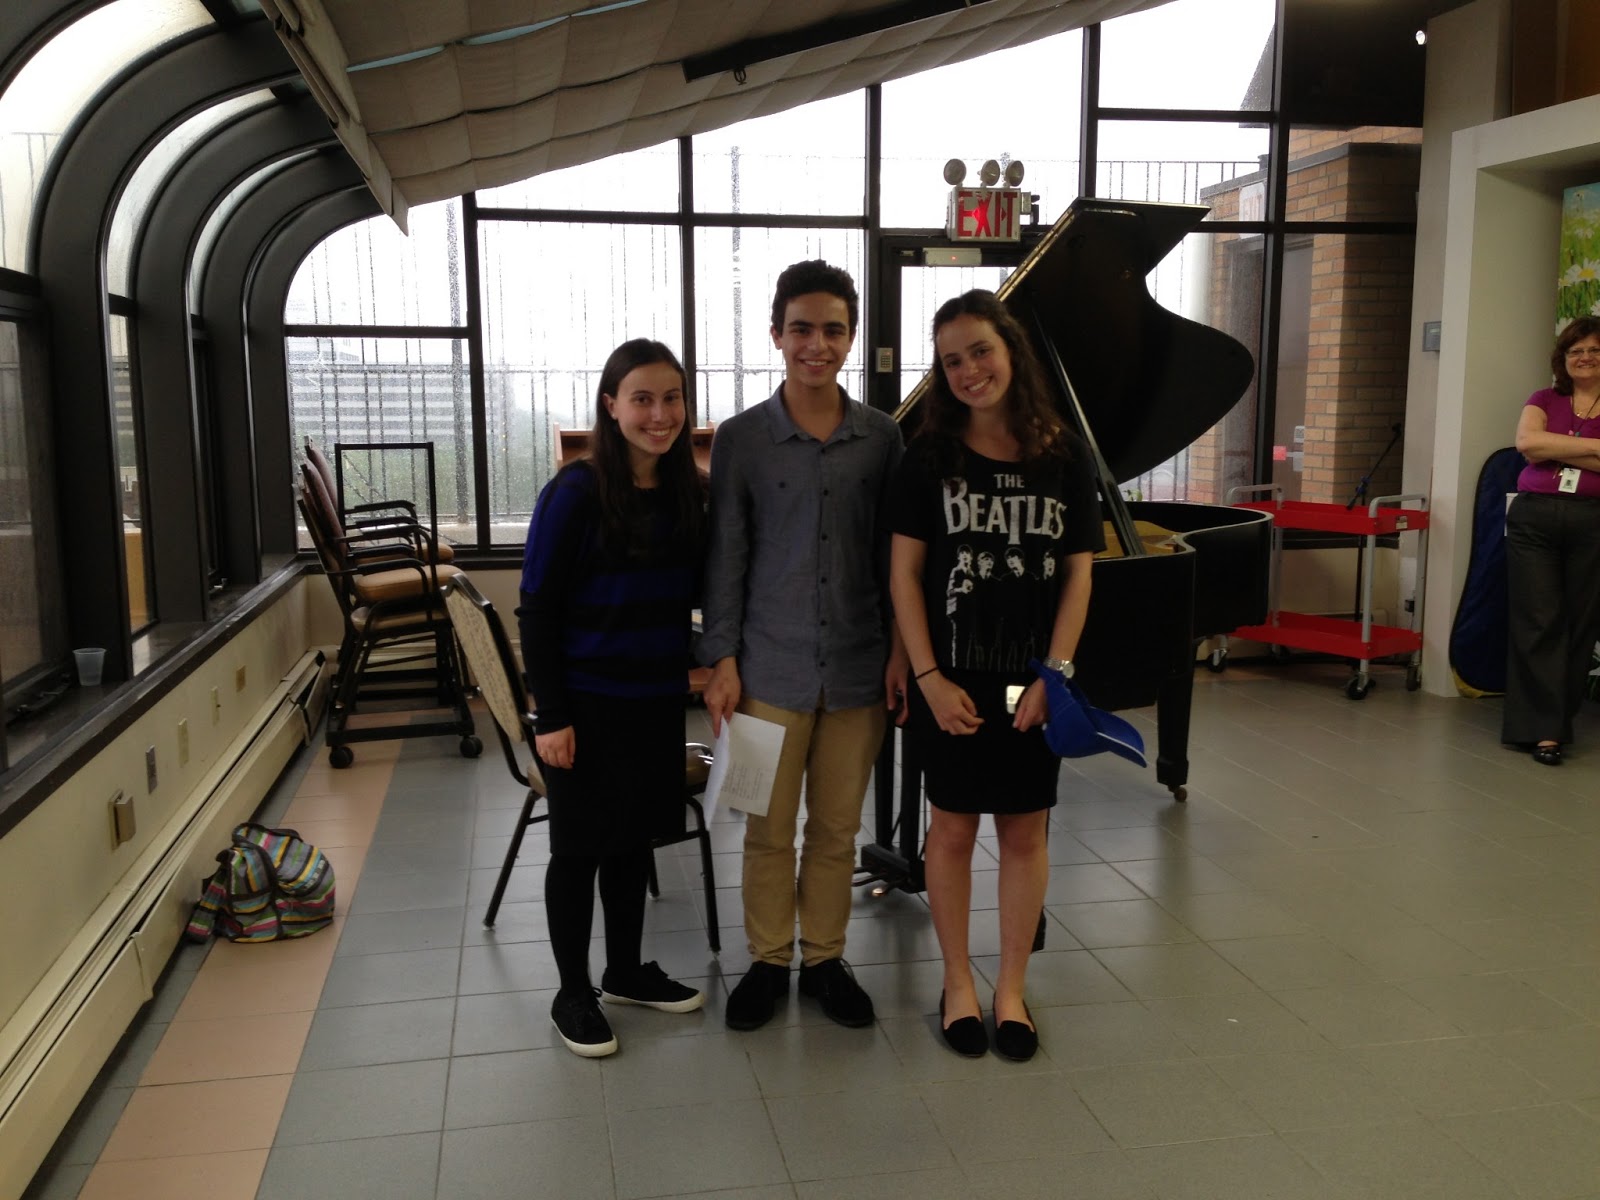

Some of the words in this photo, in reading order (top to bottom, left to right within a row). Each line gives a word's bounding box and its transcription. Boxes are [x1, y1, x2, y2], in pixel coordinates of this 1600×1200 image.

[957, 191, 1018, 237] EXIT
[993, 473, 1025, 489] THE
[942, 477, 1067, 545] BEATLES
